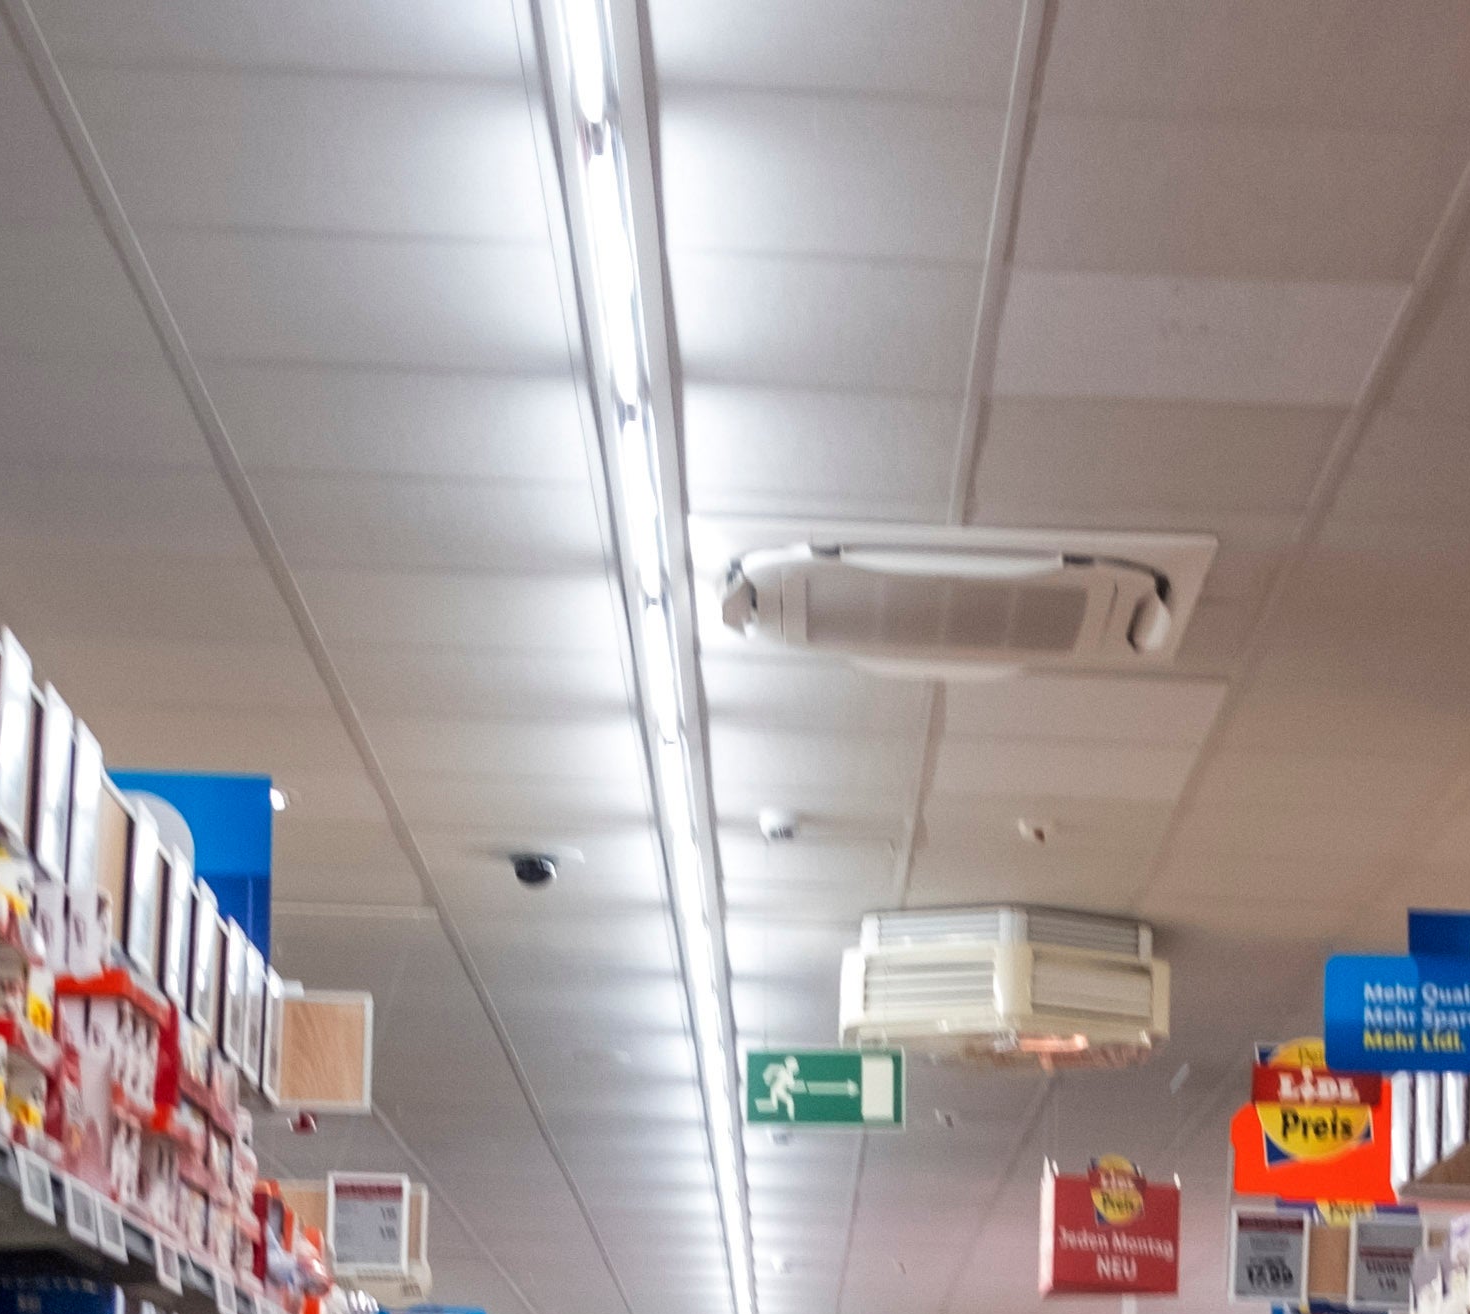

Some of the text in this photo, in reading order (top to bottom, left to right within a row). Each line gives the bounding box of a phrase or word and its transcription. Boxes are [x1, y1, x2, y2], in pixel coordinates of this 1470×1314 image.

[1364, 982, 1415, 1004] Mehr
[1364, 1005, 1415, 1028] Mehr
[1364, 1028, 1415, 1052] Mehr
[1281, 1107, 1353, 1141] Preis
[1097, 1253, 1138, 1282] NEU
